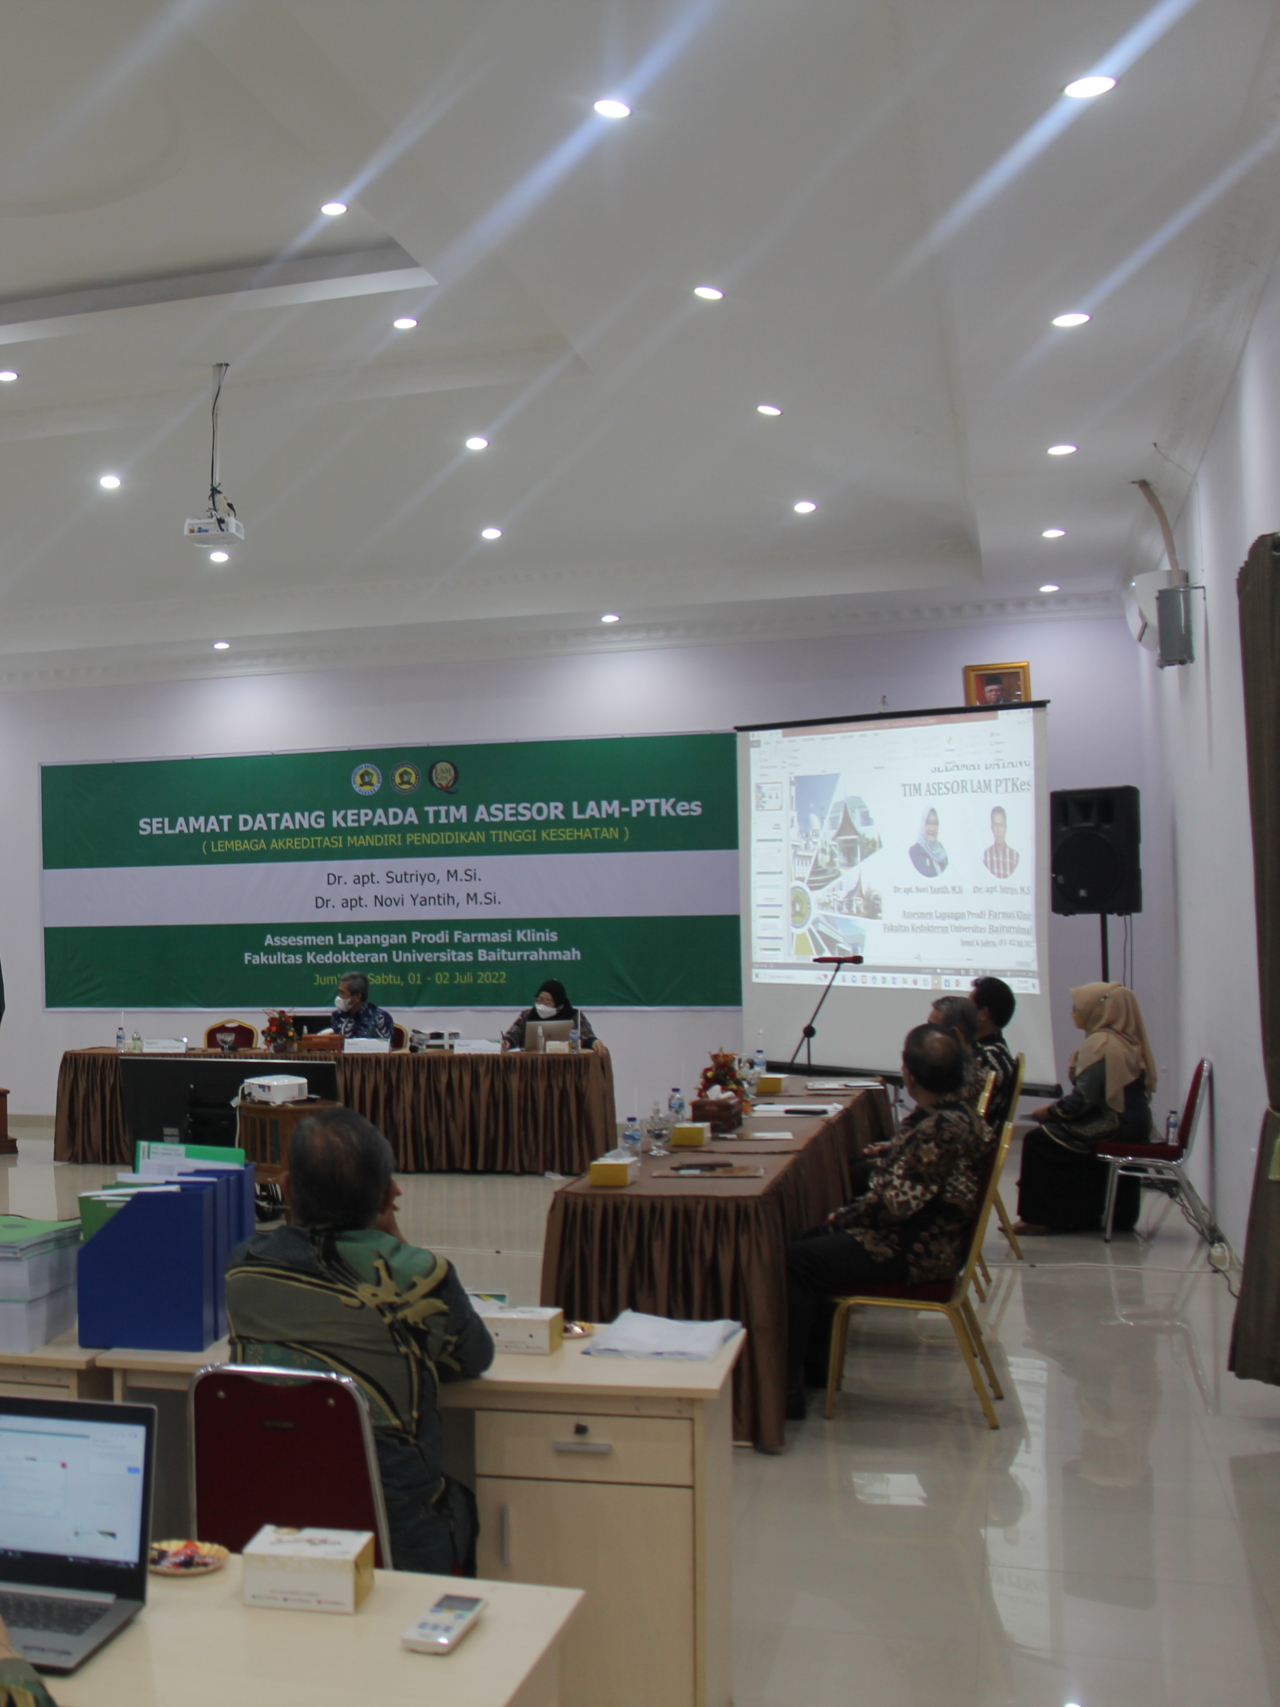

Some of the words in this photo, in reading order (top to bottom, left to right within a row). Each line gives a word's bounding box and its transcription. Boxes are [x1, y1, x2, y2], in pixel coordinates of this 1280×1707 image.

[901, 782, 922, 798] TIM
[924, 779, 969, 797] ASESOR
[970, 778, 992, 795] LAM
[995, 776, 1032, 793] PTKes
[138, 814, 232, 835] SELAMAT
[238, 811, 325, 832] DATANG
[332, 807, 419, 828] KEPADA
[424, 805, 467, 824] TIM
[474, 801, 565, 823] ASESOR
[572, 798, 702, 820] LAM-PTKes
[211, 838, 267, 853] LEMBAGA
[270, 836, 343, 850] AKREDITASI
[347, 833, 402, 847] MANDIRI
[406, 831, 485, 845] PENDIDIKAN
[489, 829, 537, 843] TINGGI
[541, 827, 619, 841] KESEHATAN
[327, 872, 347, 885] Dr.
[353, 872, 380, 887] apt.
[386, 870, 441, 886] Sutriyo,
[446, 868, 482, 882] M.Si.
[315, 896, 335, 909] Dr.
[341, 895, 368, 911] apt.
[374, 894, 404, 907] Novi
[410, 893, 460, 908] Yantih,
[466, 892, 501, 905] M.Si.
[902, 910, 933, 920] Assesmen
[934, 911, 966, 921] Lapangan
[967, 910, 986, 920] Prodi
[264, 934, 334, 946] Assesmen
[338, 932, 407, 947] Lapangan
[412, 930, 449, 944] Prodi
[454, 929, 512, 943] Farmasi
[517, 928, 558, 942] Klinis
[883, 923, 909, 934] Fakultas
[911, 924, 948, 934] Kedokteran
[950, 924, 986, 934] Universitas
[244, 952, 303, 965] Fakultas
[307, 951, 388, 964] Kedokteran
[392, 949, 474, 963] Universitas
[478, 947, 581, 962] Baiturrahmah
[367, 973, 404, 986] Sabtu,
[408, 972, 422, 984] 01
[435, 973, 450, 984] 02
[454, 972, 474, 984] Juli
[477, 971, 507, 984] 2022
